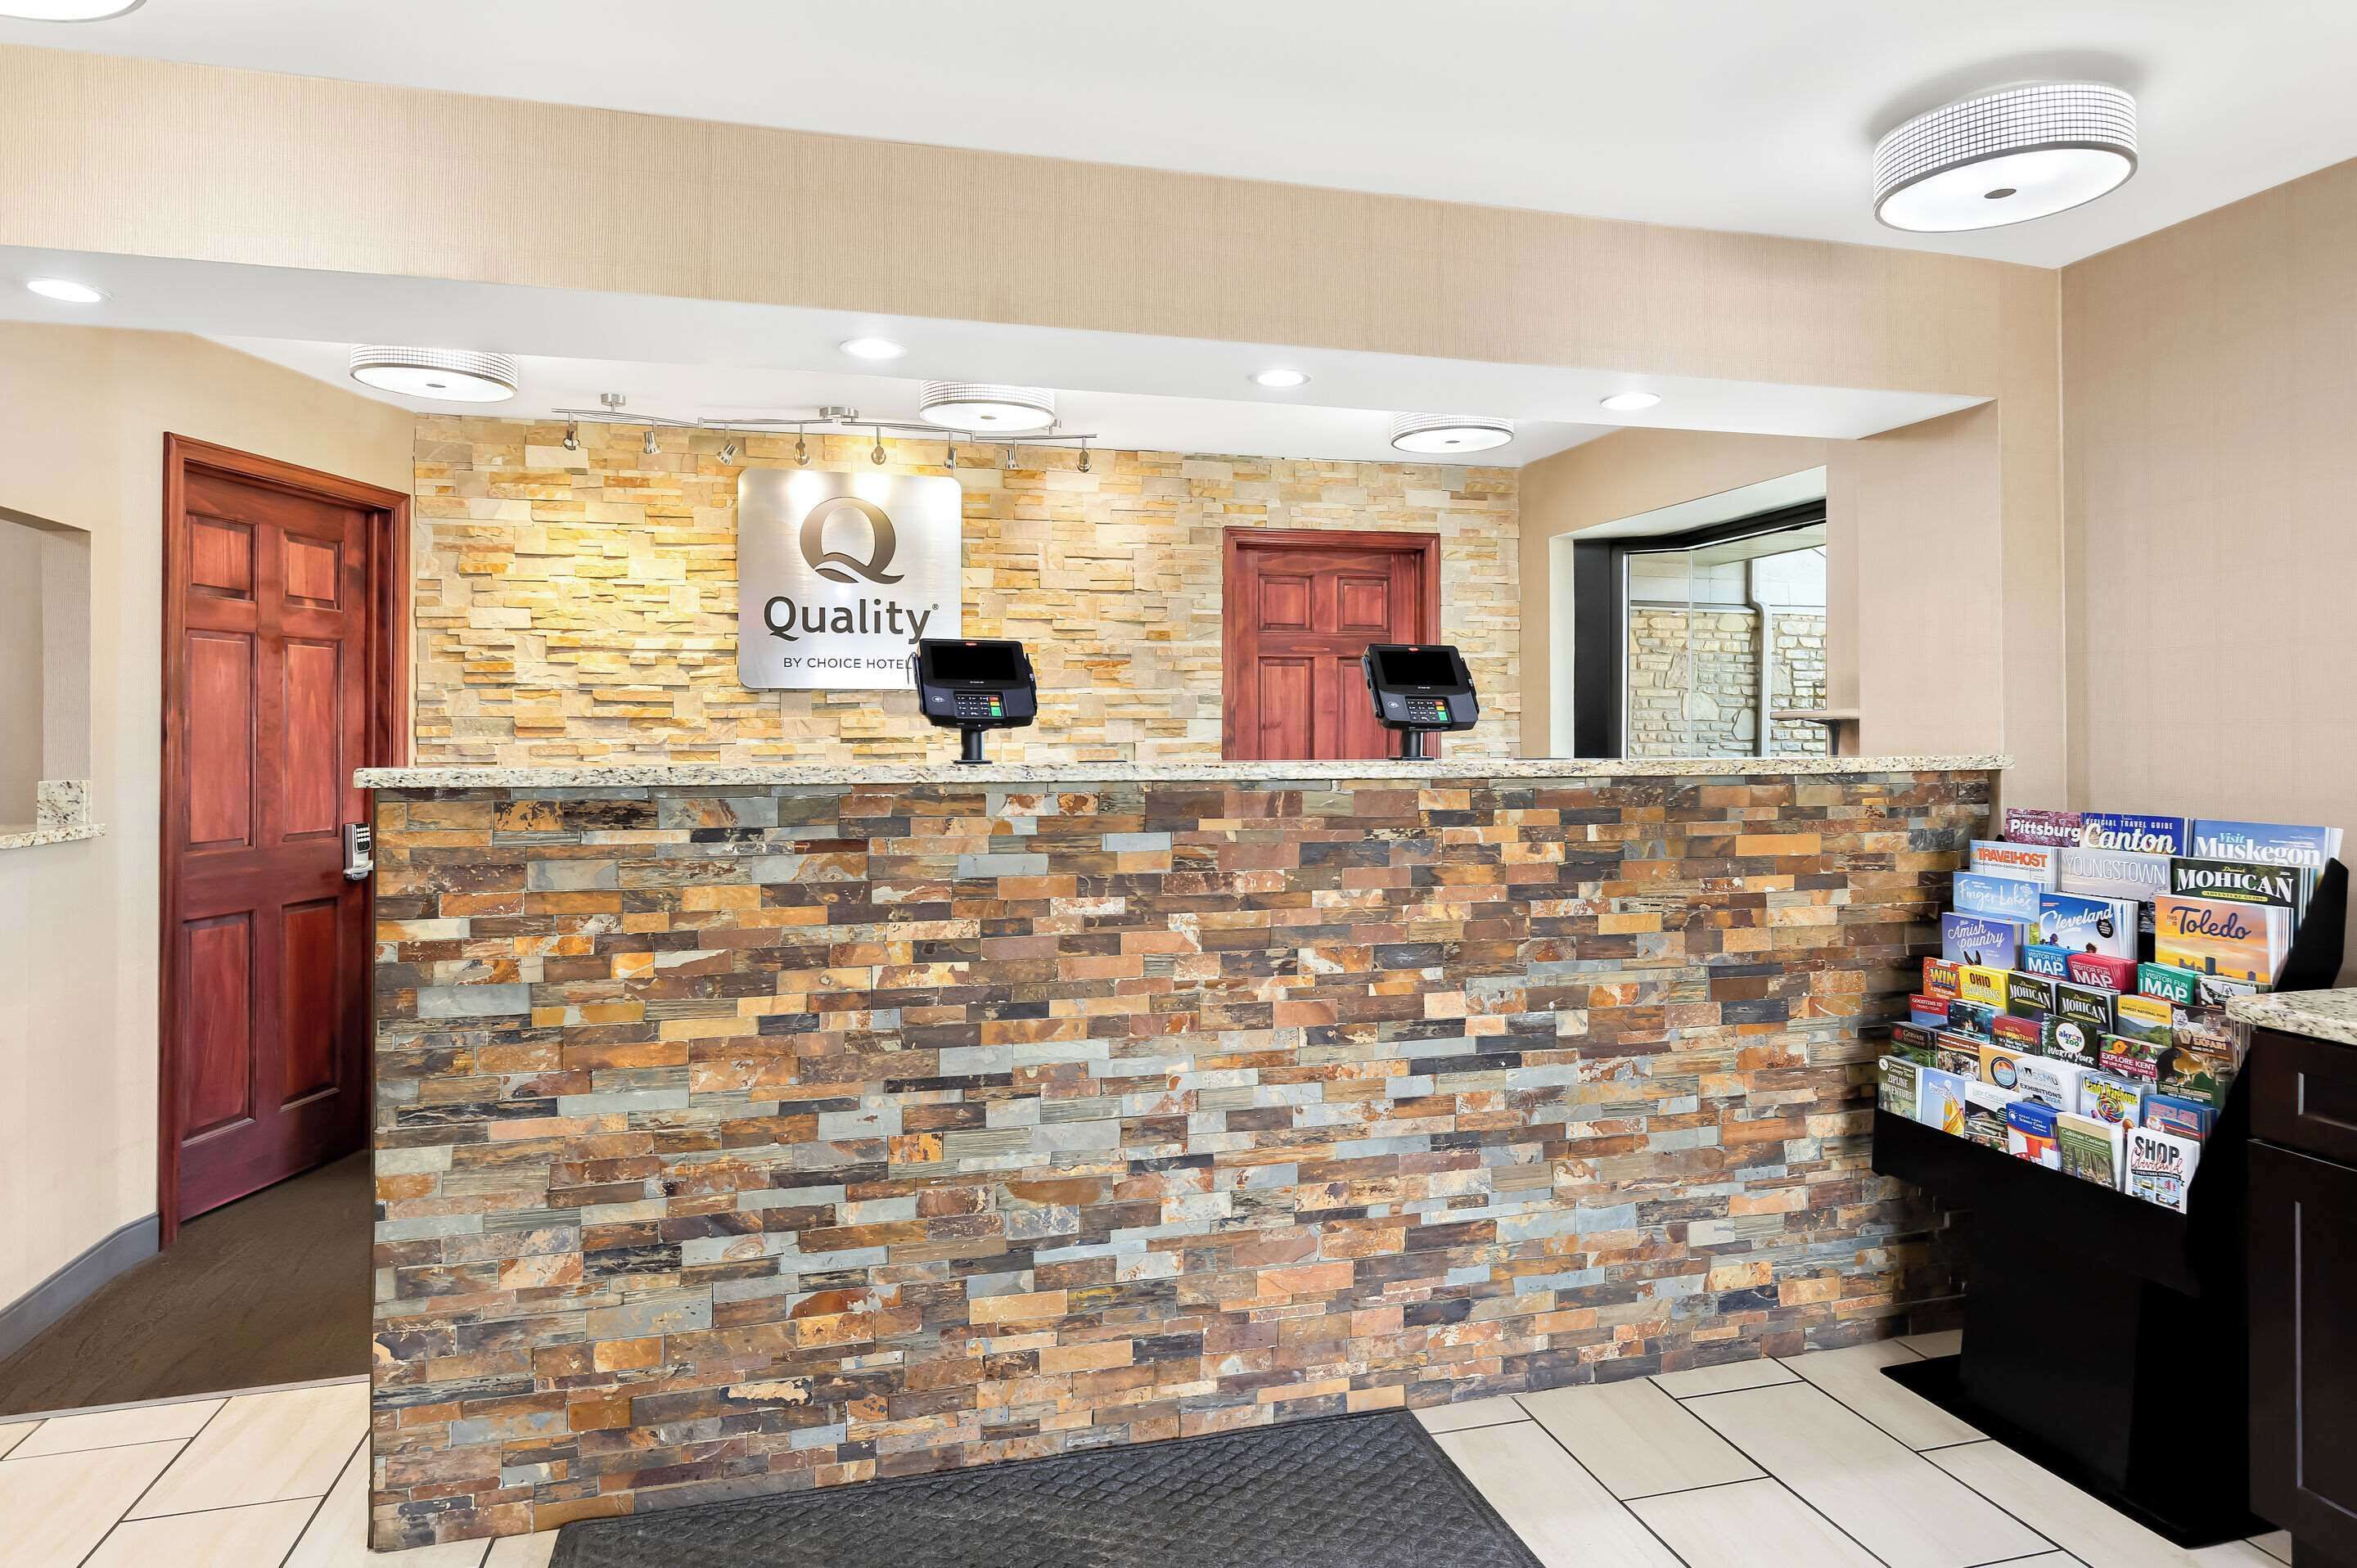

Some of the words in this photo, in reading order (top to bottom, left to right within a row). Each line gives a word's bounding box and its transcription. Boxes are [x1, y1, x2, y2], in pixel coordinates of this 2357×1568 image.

[783, 657, 800, 668] BY
[807, 658, 861, 669] CHOICE
[867, 659, 913, 669] HOTEL
[2010, 819, 2081, 842] Pittsburg
[2086, 818, 2116, 827] OFFICIAL
[2121, 820, 2147, 828] TRAVEL
[2151, 822, 2173, 830] GUIDE
[2084, 823, 2177, 854] Canton
[2219, 832, 2246, 845] Visit
[1976, 848, 2048, 867] TRAVELHOST
[2195, 836, 2320, 866] Muskegon
[2067, 855, 2166, 885] YOUNGSTOWN
[1958, 879, 1994, 911] Finger
[1999, 884, 2033, 910] Lakes
[2176, 868, 2294, 903] MOHICAN
[2040, 903, 2116, 934] Cleveland
[2171, 906, 2251, 939] Toledo
[1948, 919, 1986, 939] Amish
[1958, 930, 2004, 950] Country
[2028, 951, 2050, 960] VISITOR
[2051, 955, 2063, 963] FUN
[2028, 957, 2064, 975] MAP
[1930, 968, 1957, 987] WIN
[2071, 962, 2095, 972] VISITOR
[2097, 966, 2111, 975] FUN
[1969, 972, 1991, 988] OHIO
[2072, 969, 2113, 988] MAP
[2146, 971, 2172, 985] VISITOR
[2174, 980, 2188, 989] FUN
[1963, 983, 2002, 1001] CAVERNS
[2009, 984, 2051, 1009] MOHICAN
[2145, 978, 2188, 1003] MAP
[2062, 997, 2107, 1024] MOHICAN
[2058, 1030, 2082, 1043] akron
[2102, 1052, 2134, 1066] EXPLORE
[2135, 1060, 2156, 1071] KENT
[1887, 1073, 1909, 1088] ZIPLINE
[1882, 1083, 1913, 1101] ADVENTURE
[2020, 1083, 2062, 1099] EXHIBITIONS
[2045, 1096, 2062, 1104] 2024
[2083, 1077, 2103, 1093] Candy
[2103, 1080, 2138, 1106] Warehouse
[2062, 1129, 2084, 1141] Cultivate
[2084, 1135, 2108, 1149] Curiosity
[2135, 1136, 2179, 1165] SHOP
[2131, 1147, 2183, 1174] Cleveland
